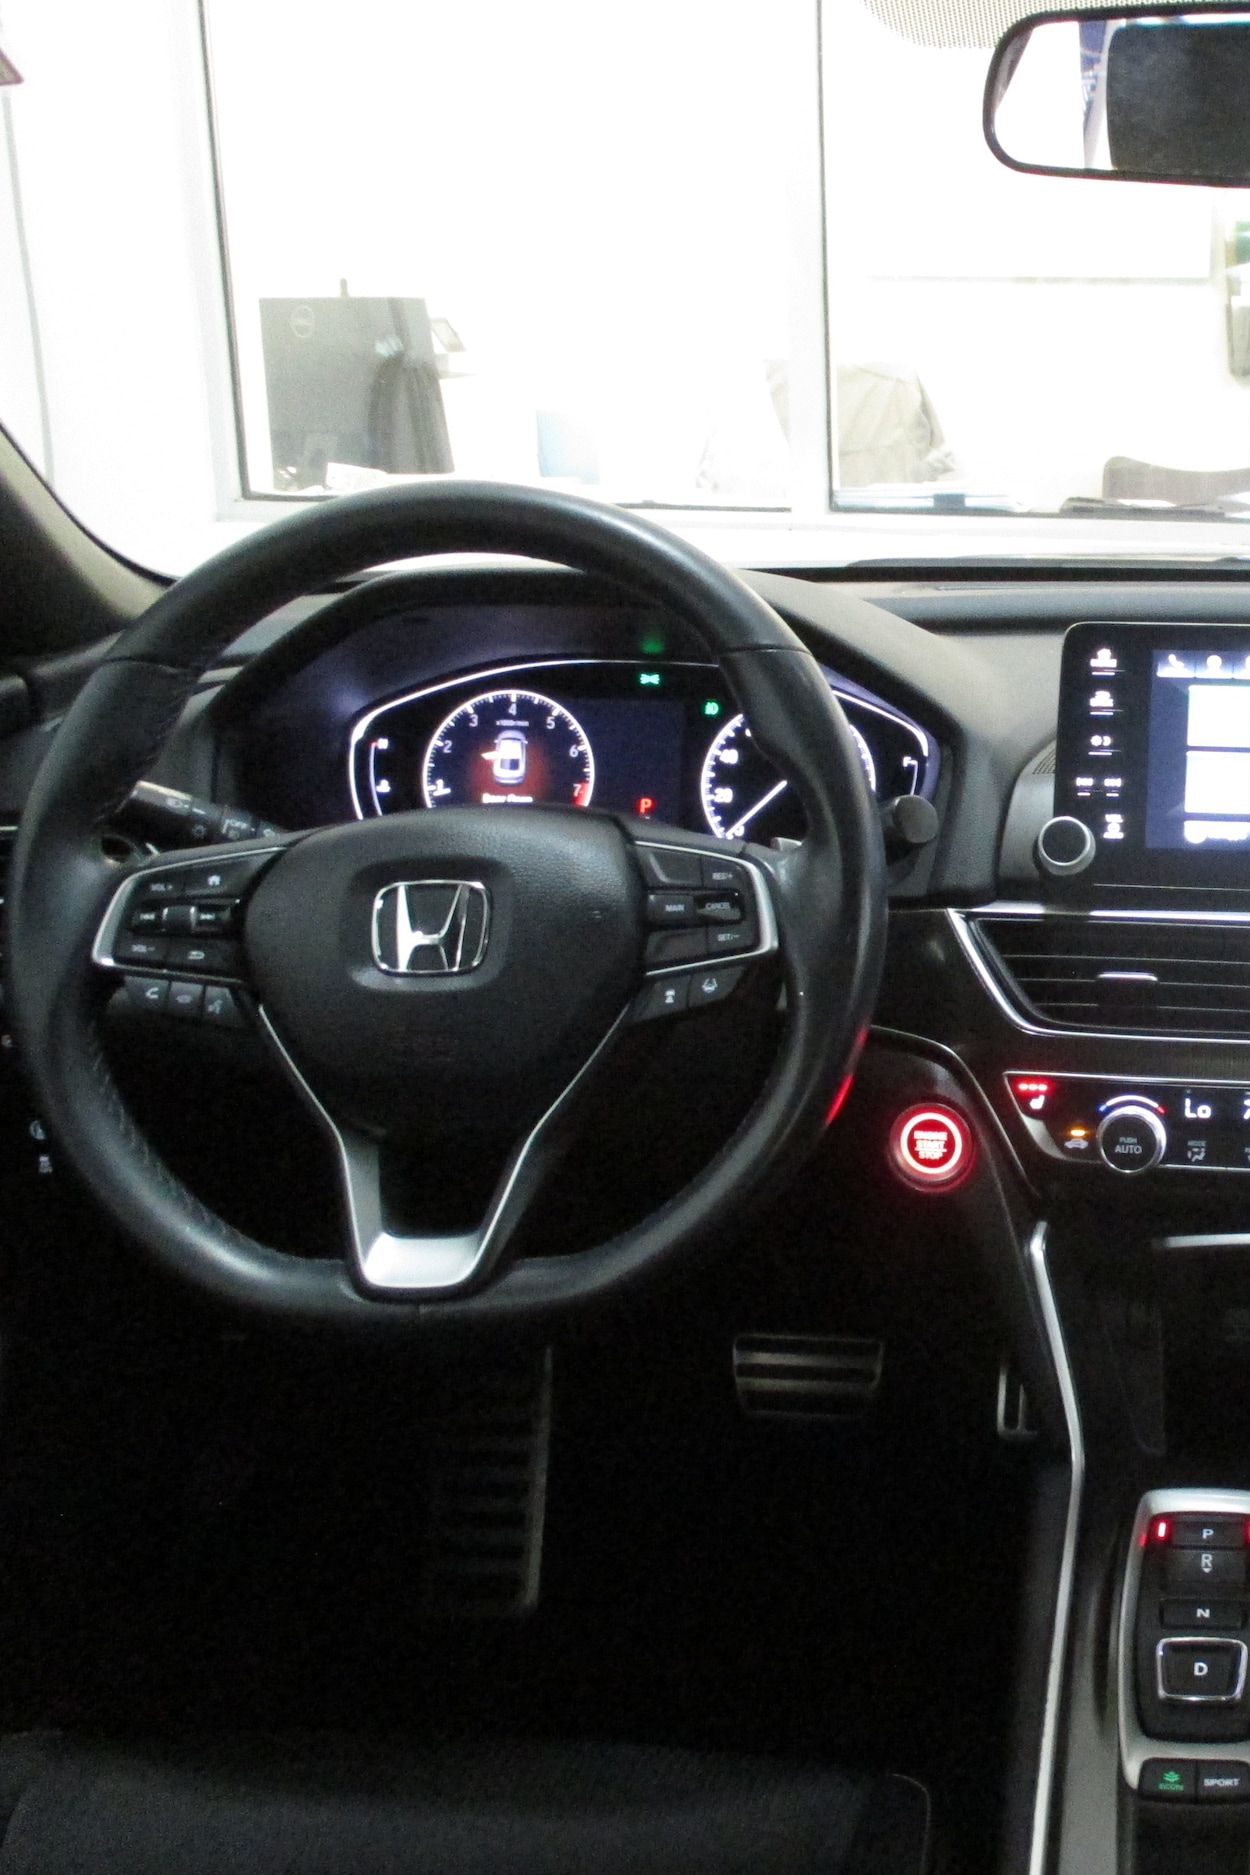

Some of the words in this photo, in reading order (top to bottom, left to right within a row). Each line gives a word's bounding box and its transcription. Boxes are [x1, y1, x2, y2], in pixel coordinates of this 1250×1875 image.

[508, 703, 517, 716] 4
[469, 714, 479, 728] 3
[546, 716, 556, 730] 5
[443, 740, 453, 754] 2
[569, 744, 579, 758] 6
[573, 784, 582, 797] 7
[640, 798, 652, 813] P
[665, 904, 685, 912] MAIN
[705, 902, 731, 910] CANCEL
[1184, 1098, 1212, 1119] Lo
[915, 1140, 945, 1150] START
[1114, 1145, 1143, 1154] AUTO
[918, 1151, 943, 1160] STOP
[1202, 1528, 1214, 1540] P
[1201, 1553, 1213, 1569] R
[1196, 1608, 1210, 1618] N
[1193, 1662, 1209, 1676] D
[1158, 1783, 1184, 1791] ECON
[1203, 1778, 1240, 1787] SPORT
